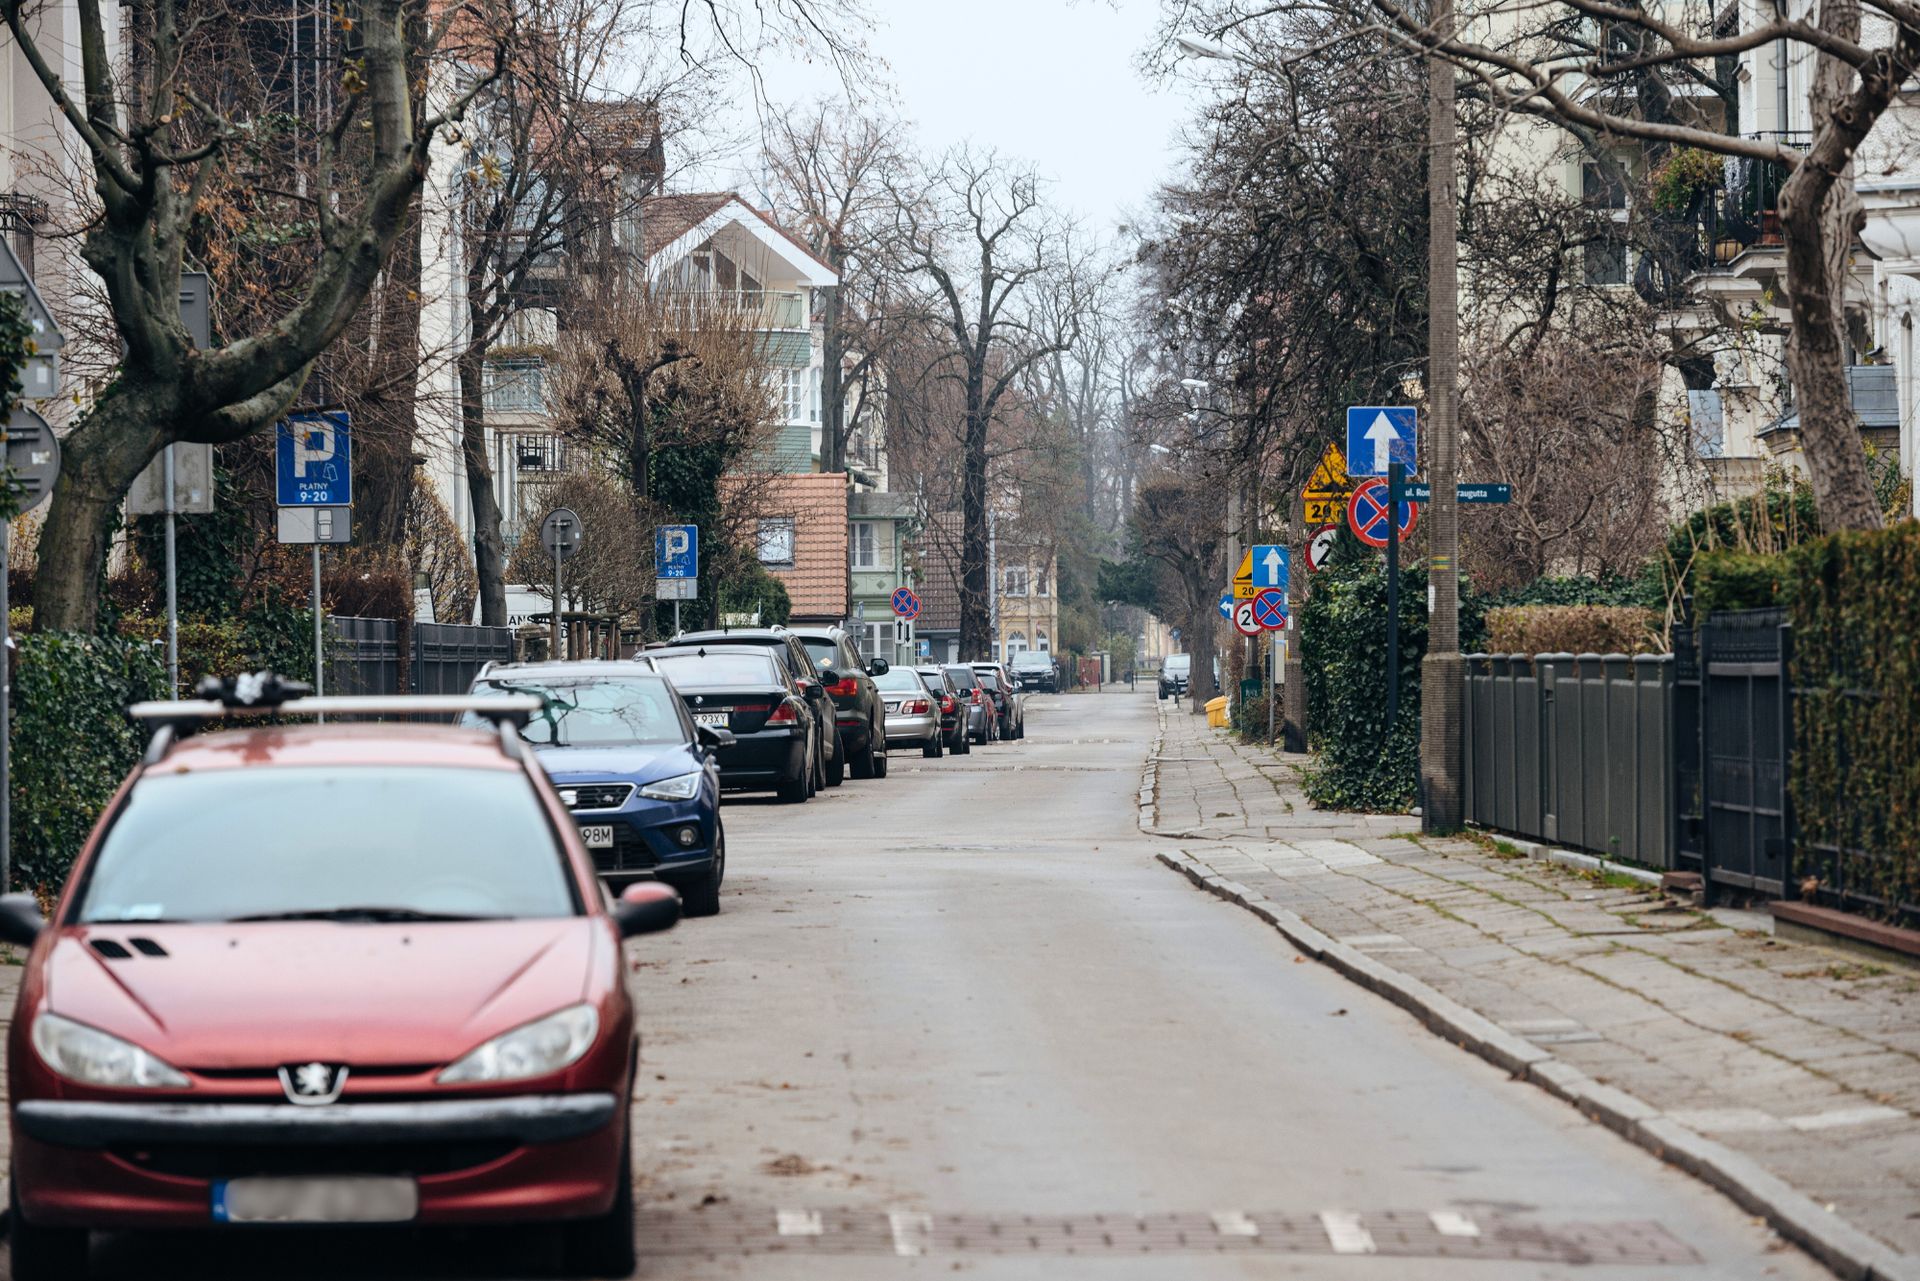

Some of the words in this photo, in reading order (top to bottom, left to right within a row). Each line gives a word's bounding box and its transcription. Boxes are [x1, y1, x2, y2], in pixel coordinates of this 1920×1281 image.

[294, 421, 335, 478] P
[300, 491, 328, 502] 9-20
[1457, 490, 1488, 500] raugutta
[1311, 504, 1331, 518] 20
[1242, 586, 1255, 596] 20
[583, 828, 611, 844] 98M
